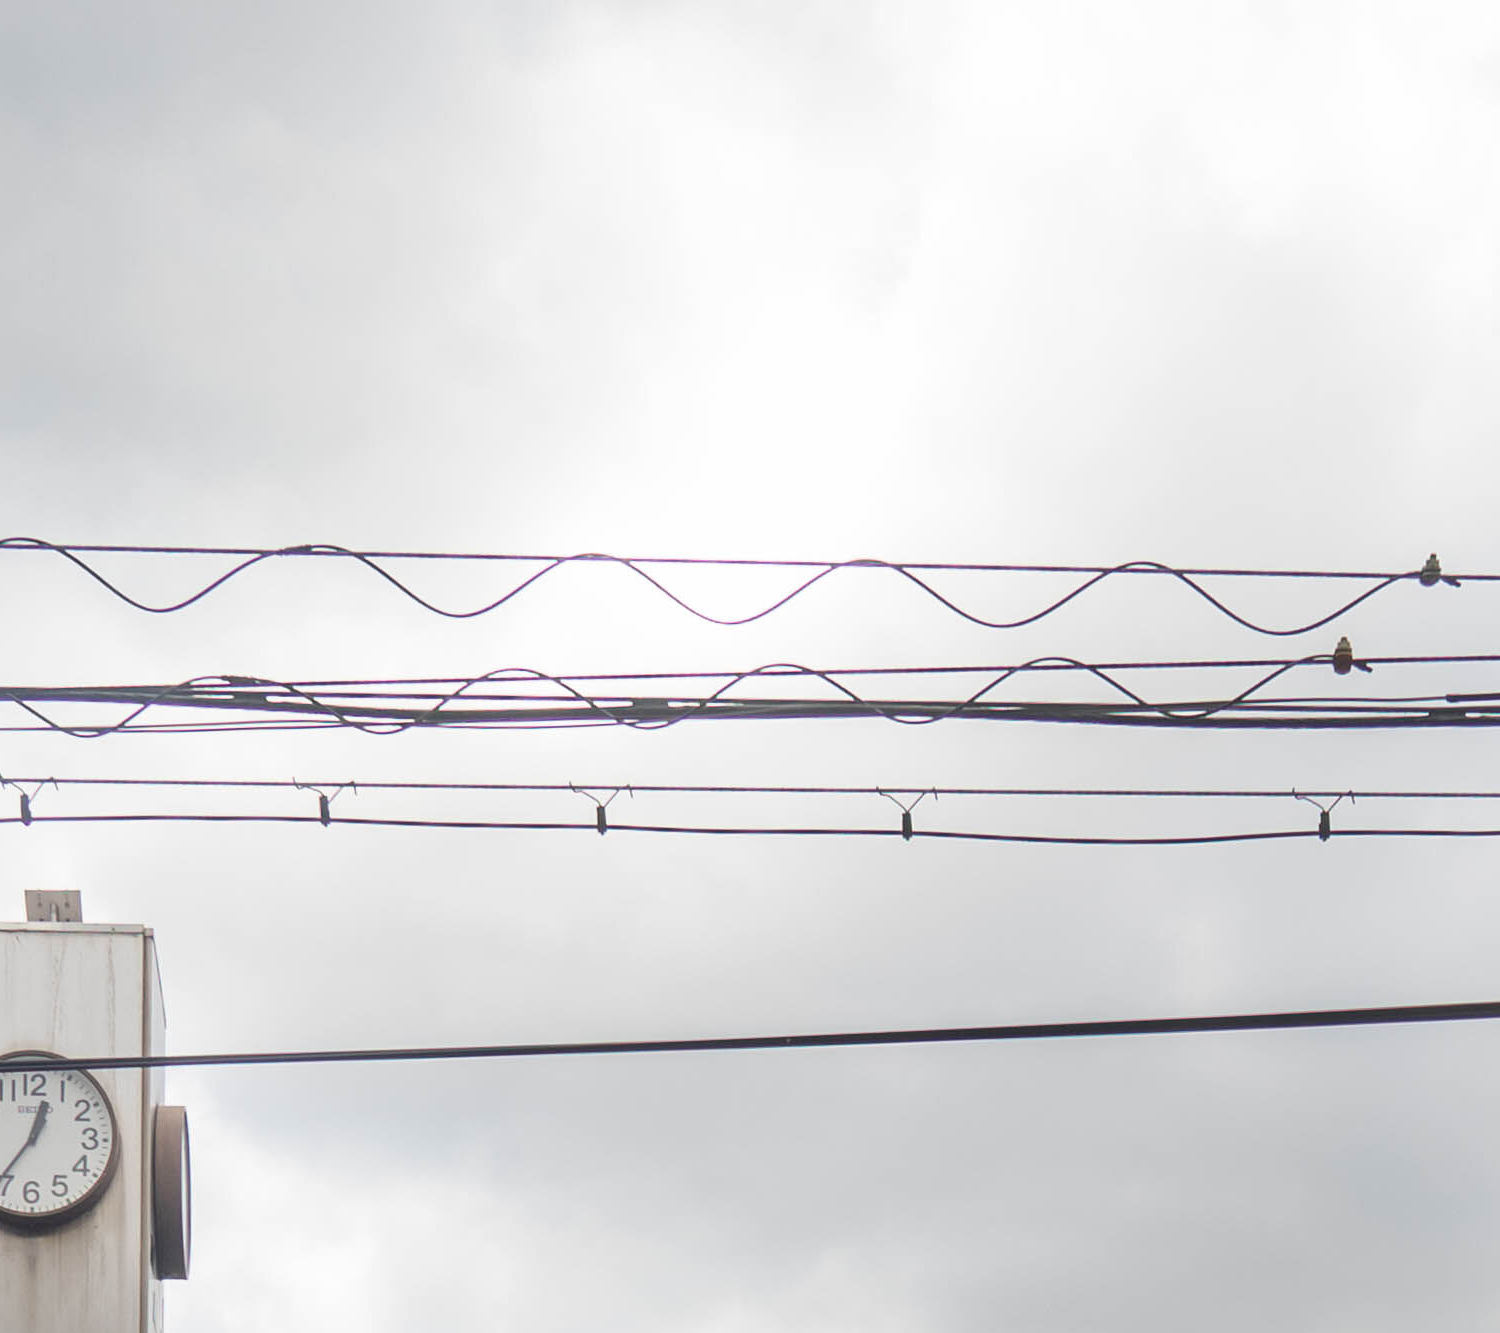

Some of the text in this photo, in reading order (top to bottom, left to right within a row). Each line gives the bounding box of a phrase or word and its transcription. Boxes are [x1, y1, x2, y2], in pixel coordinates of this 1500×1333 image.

[0, 1079, 16, 1102] 11
[23, 1074, 47, 1097] 12
[60, 1080, 66, 1103] 1
[74, 1099, 91, 1122] 2
[81, 1127, 99, 1151] 3
[72, 1154, 90, 1177] 4
[23, 1180, 40, 1204] 6
[51, 1174, 69, 1197] 5
